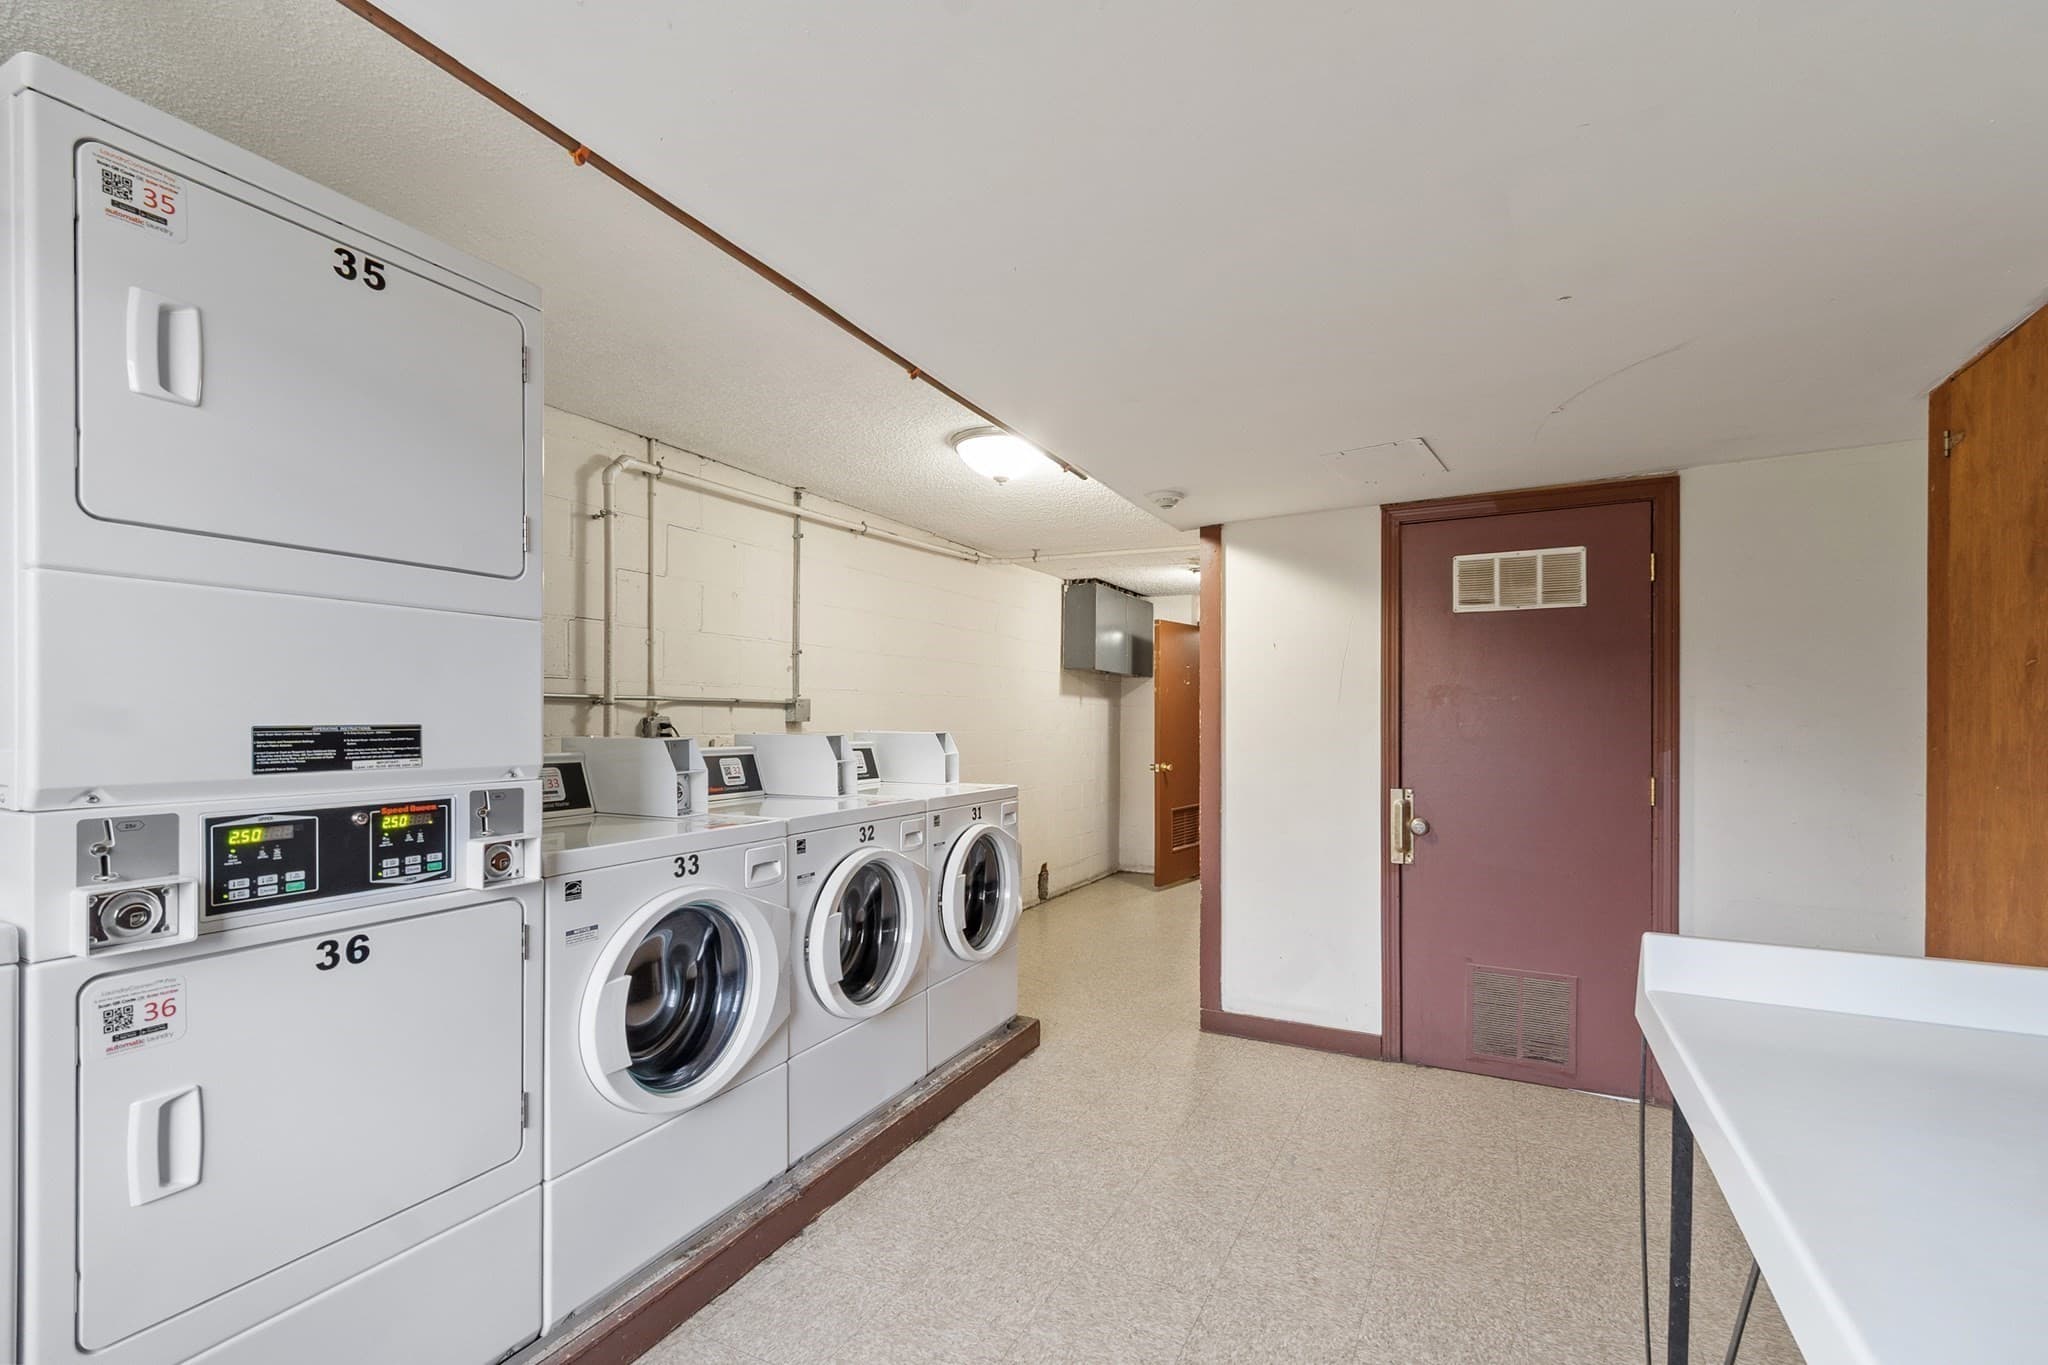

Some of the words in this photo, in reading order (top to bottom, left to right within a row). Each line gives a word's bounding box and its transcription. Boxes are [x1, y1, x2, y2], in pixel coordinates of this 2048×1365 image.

[143, 187, 176, 215] 35
[104, 207, 145, 226] automatic
[333, 247, 386, 291] 35
[546, 778, 560, 789] 33
[381, 805, 409, 815] Speed
[409, 804, 438, 813] Queen
[972, 806, 982, 821] 31
[859, 825, 875, 843] 32
[674, 855, 699, 878] 33
[316, 934, 370, 971] 36
[144, 997, 177, 1022] 36
[105, 1039, 144, 1053] automatic
[146, 1031, 175, 1043] laundry
